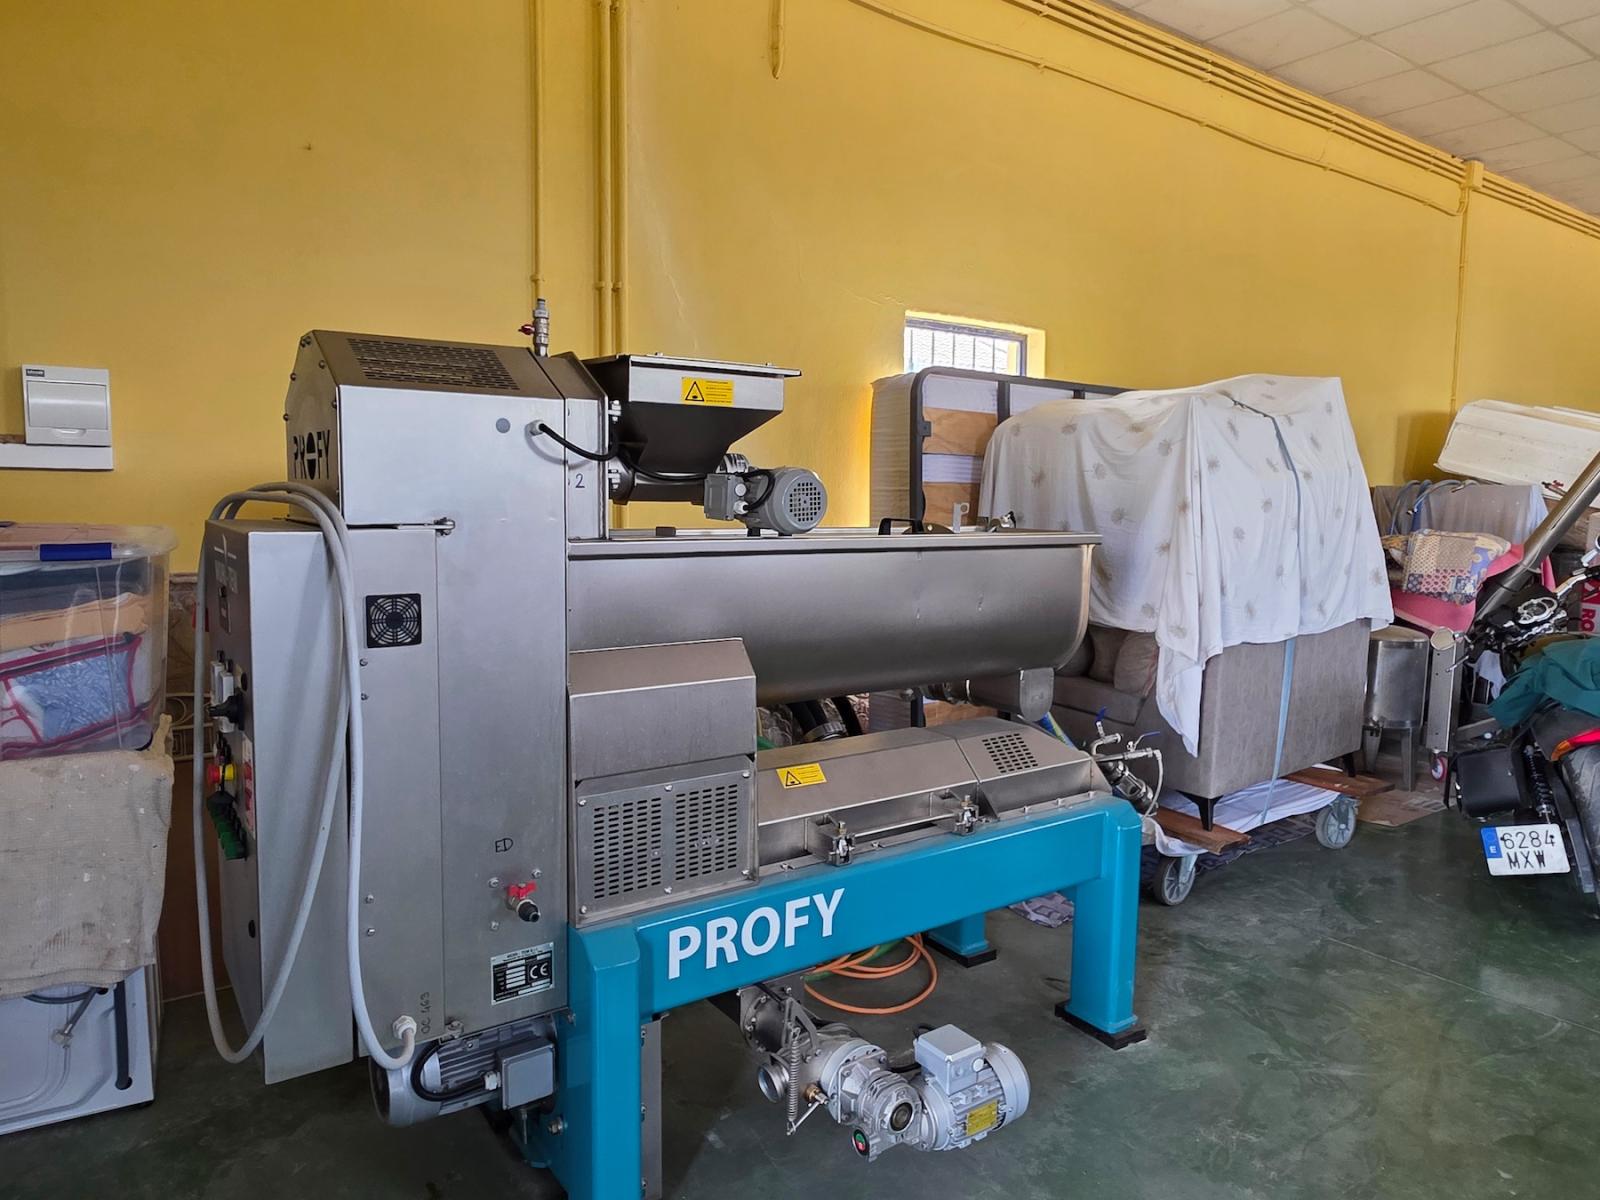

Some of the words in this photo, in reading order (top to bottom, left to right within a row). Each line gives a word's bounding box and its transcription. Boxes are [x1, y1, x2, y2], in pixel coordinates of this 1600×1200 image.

[293, 429, 330, 480] PROFY
[575, 472, 586, 489] 2
[1489, 845, 1497, 854] E
[1501, 829, 1556, 850] 6284
[1506, 849, 1546, 870] MXW
[668, 887, 846, 980] PROFY
